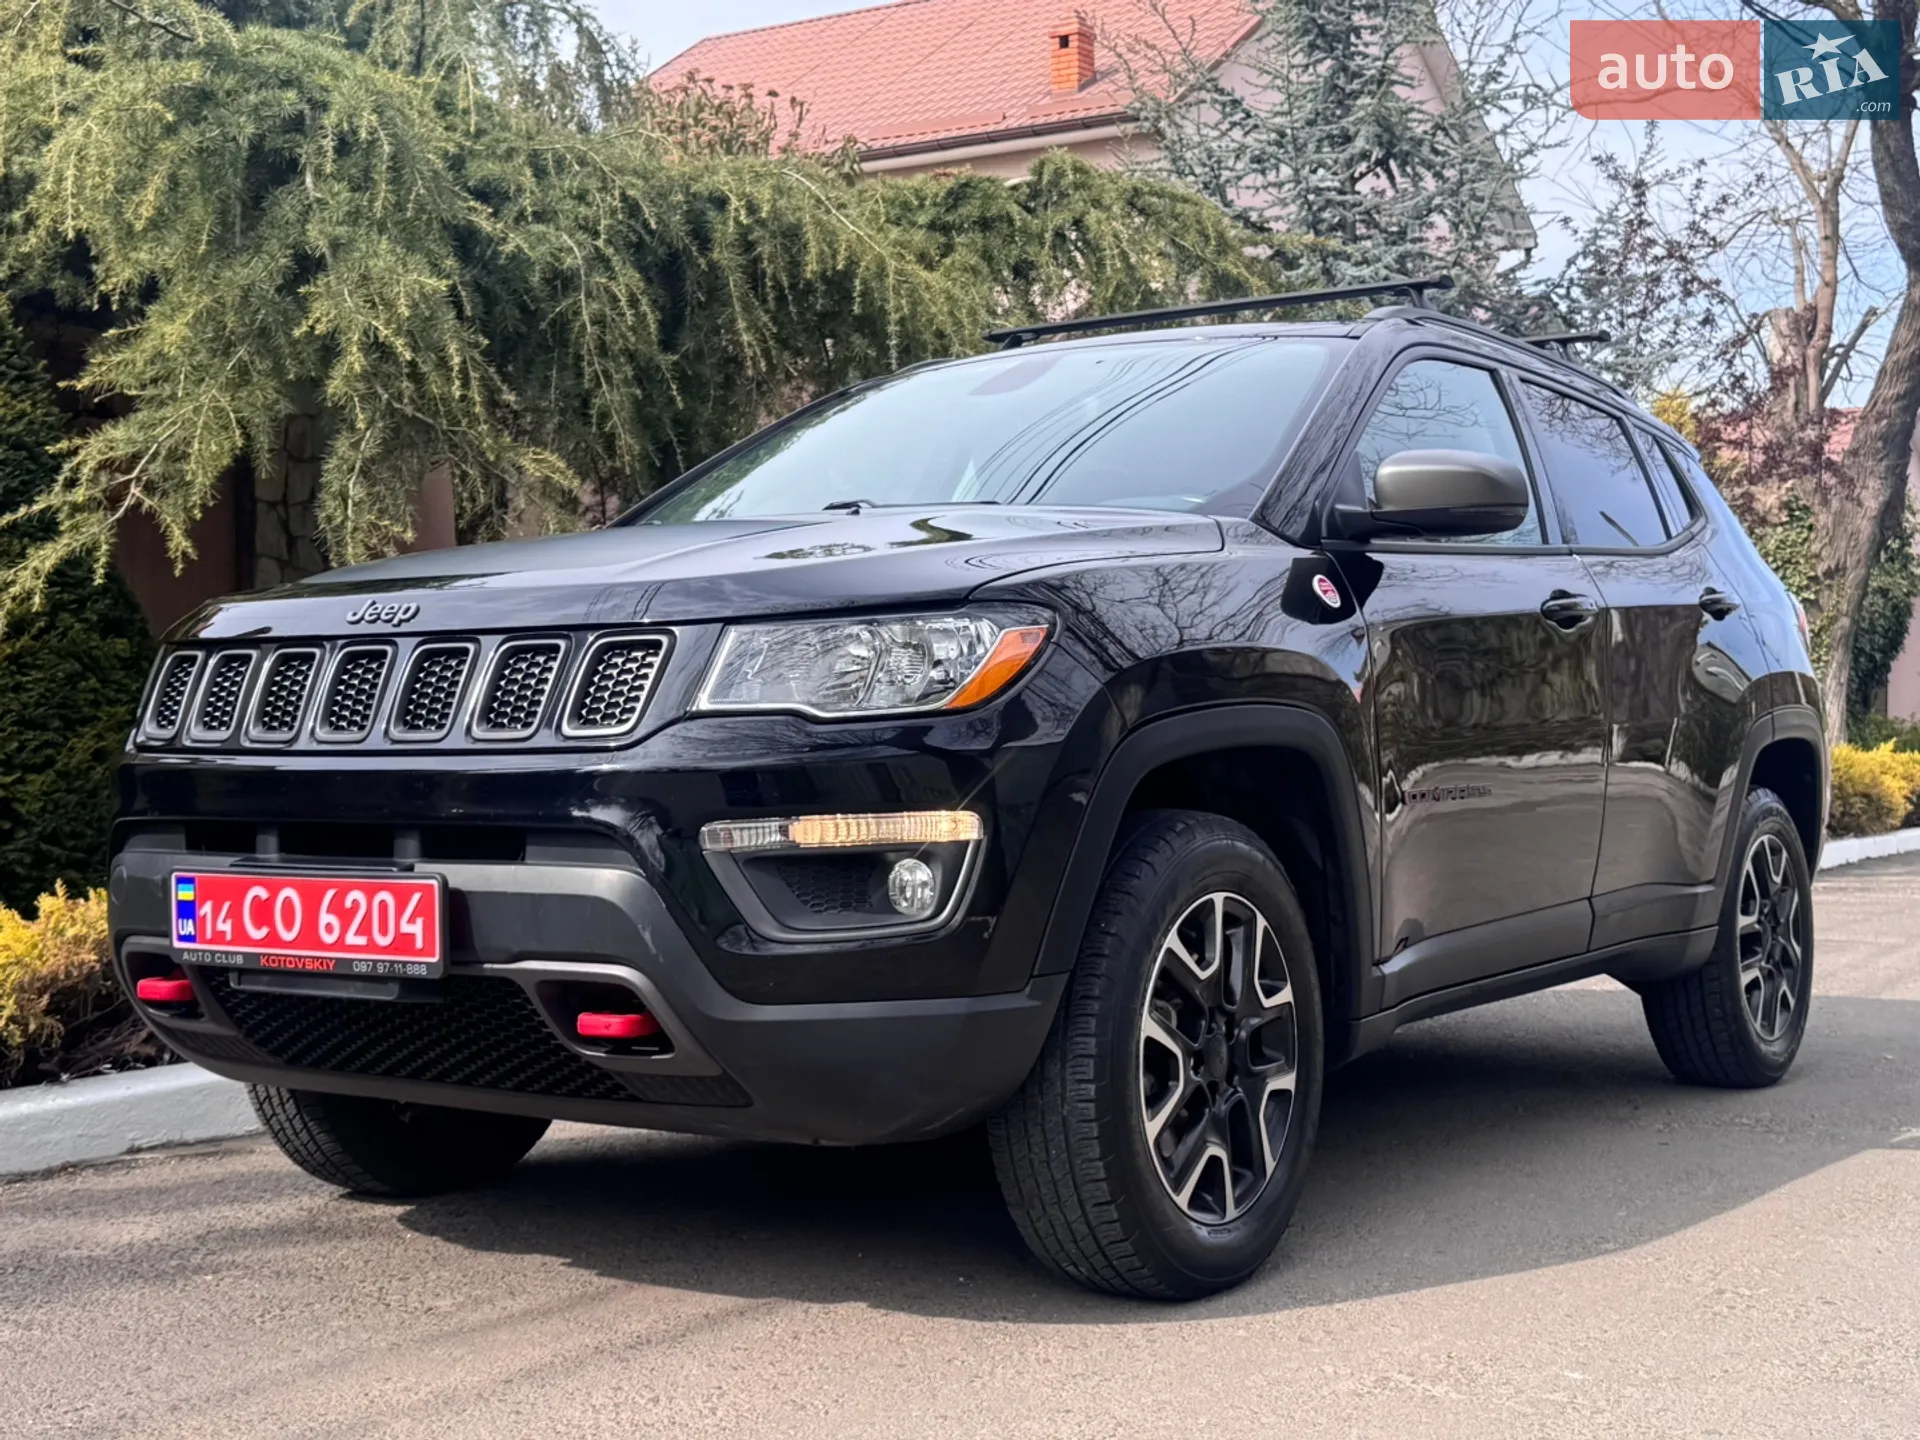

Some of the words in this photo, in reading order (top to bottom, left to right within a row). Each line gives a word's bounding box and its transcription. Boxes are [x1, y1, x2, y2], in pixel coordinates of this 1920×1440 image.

[346, 599, 420, 627] Jeep
[178, 918, 195, 936] UA
[199, 900, 232, 941] 14
[243, 885, 302, 942] CO
[318, 888, 424, 950] 6204
[182, 952, 211, 963] AUTO
[214, 953, 244, 965] CLUB
[260, 955, 336, 971] KOTOVSKIY
[353, 960, 373, 973] 097
[377, 962, 428, 976] 97-11-888
